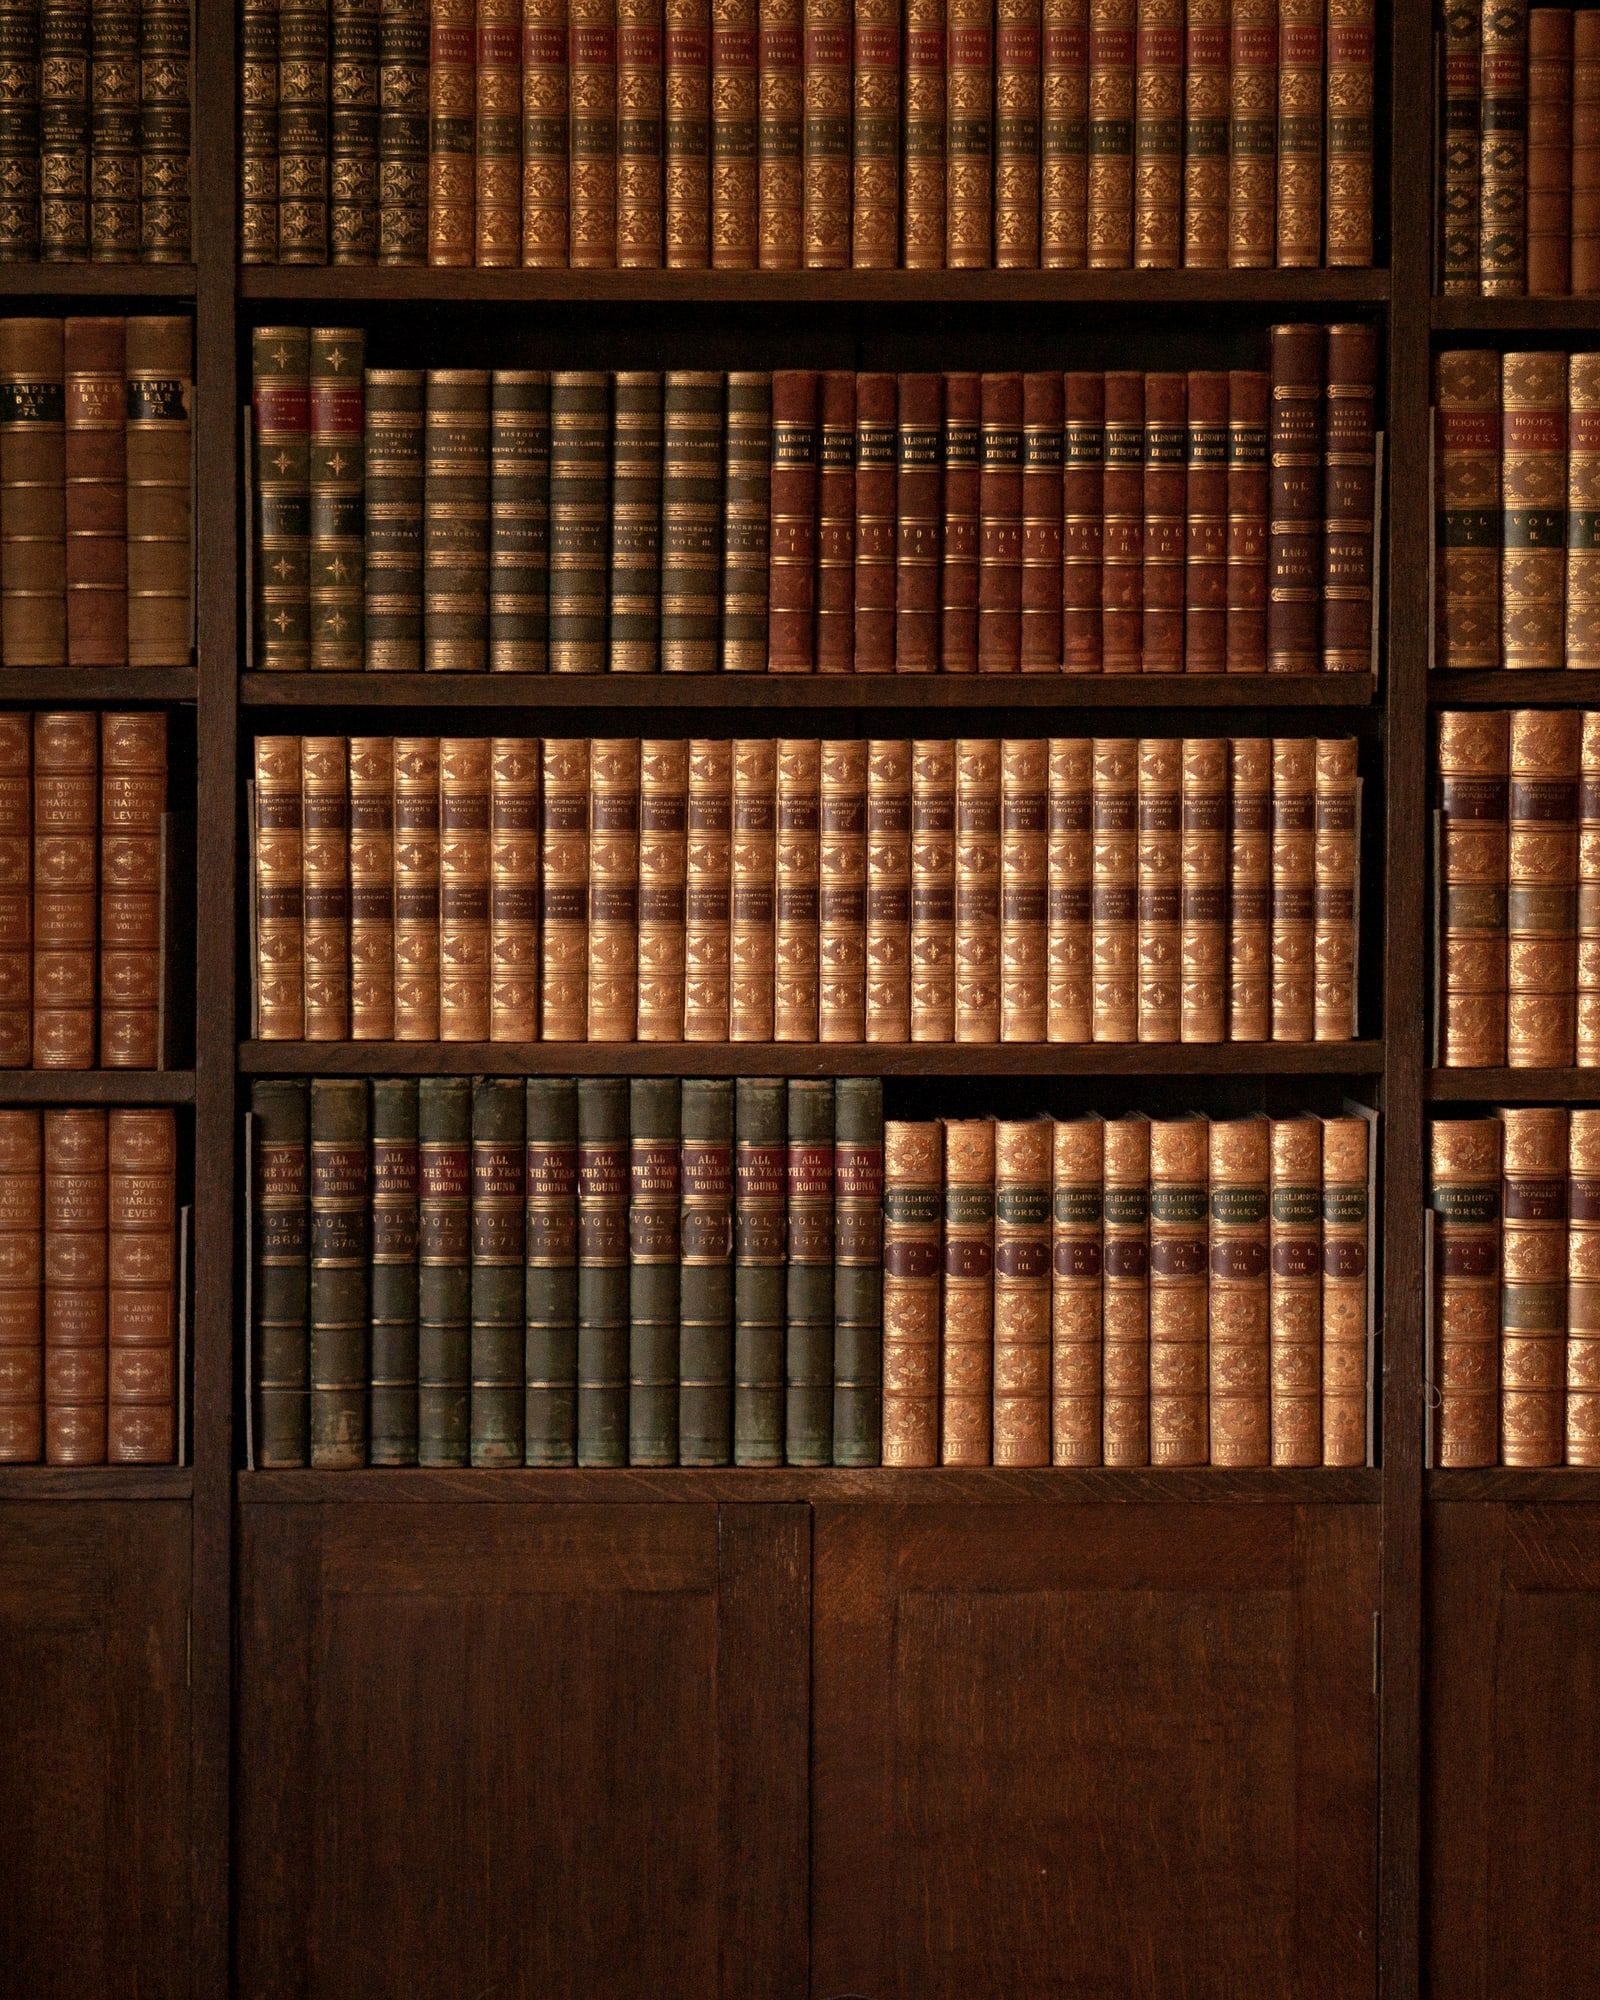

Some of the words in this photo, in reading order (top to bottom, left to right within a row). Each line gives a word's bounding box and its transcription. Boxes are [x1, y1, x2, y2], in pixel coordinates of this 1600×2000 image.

[16, 396, 44, 404] BAR
[82, 394, 109, 402] BAR
[143, 392, 172, 401] BAR
[1330, 547, 1364, 556] WATER
[41, 799, 87, 807] CHARLES
[108, 799, 155, 807] CHARLES
[45, 811, 81, 819] LEVER
[113, 811, 150, 819] LEVER
[273, 1154, 291, 1163] ALL
[435, 1157, 455, 1165] ALL
[646, 1155, 666, 1163] ALL
[751, 1156, 770, 1165] ALL
[850, 1156, 869, 1165] ALL
[260, 1168, 276, 1176] HE
[424, 1169, 441, 1177] THE
[632, 1167, 650, 1175] THE
[738, 1168, 756, 1176] THE
[838, 1168, 854, 1177] THE
[116, 1197, 163, 1205] CHARLES
[56, 1209, 94, 1217] LEVER
[122, 1209, 157, 1217] LEVER
